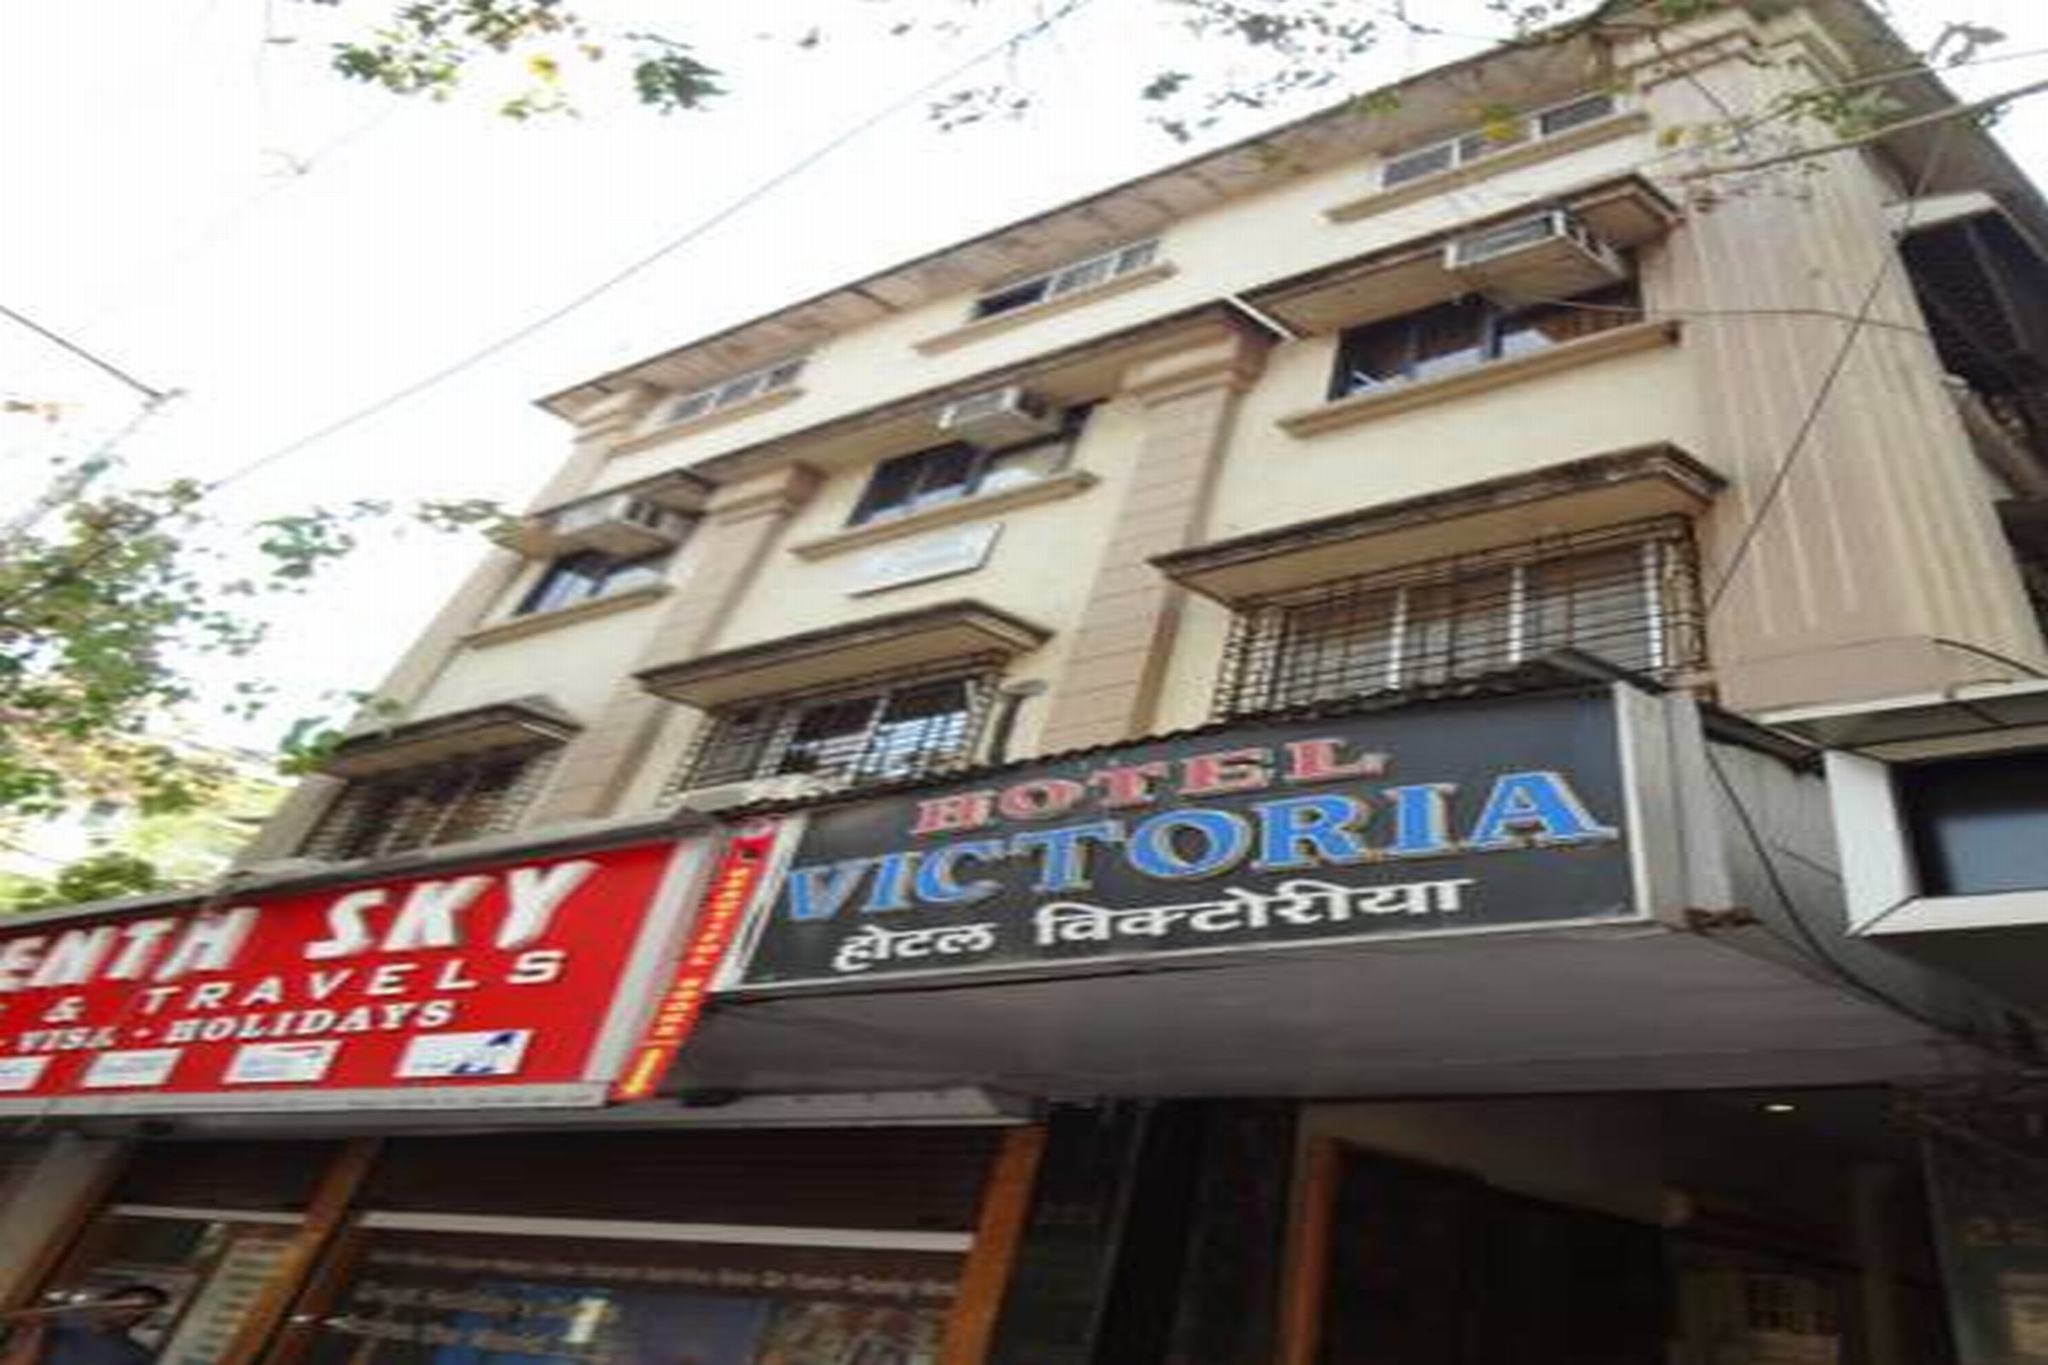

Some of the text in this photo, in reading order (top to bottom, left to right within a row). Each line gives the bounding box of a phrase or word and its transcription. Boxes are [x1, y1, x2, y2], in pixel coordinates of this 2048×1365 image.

[909, 737, 1388, 835] HOTEL
[786, 770, 1619, 921] VICTORIA
[303, 859, 601, 960] SKY
[831, 922, 998, 973] होटल
[43, 949, 568, 1023] & TRAVELS
[163, 999, 458, 1045] HOLIDAYS
